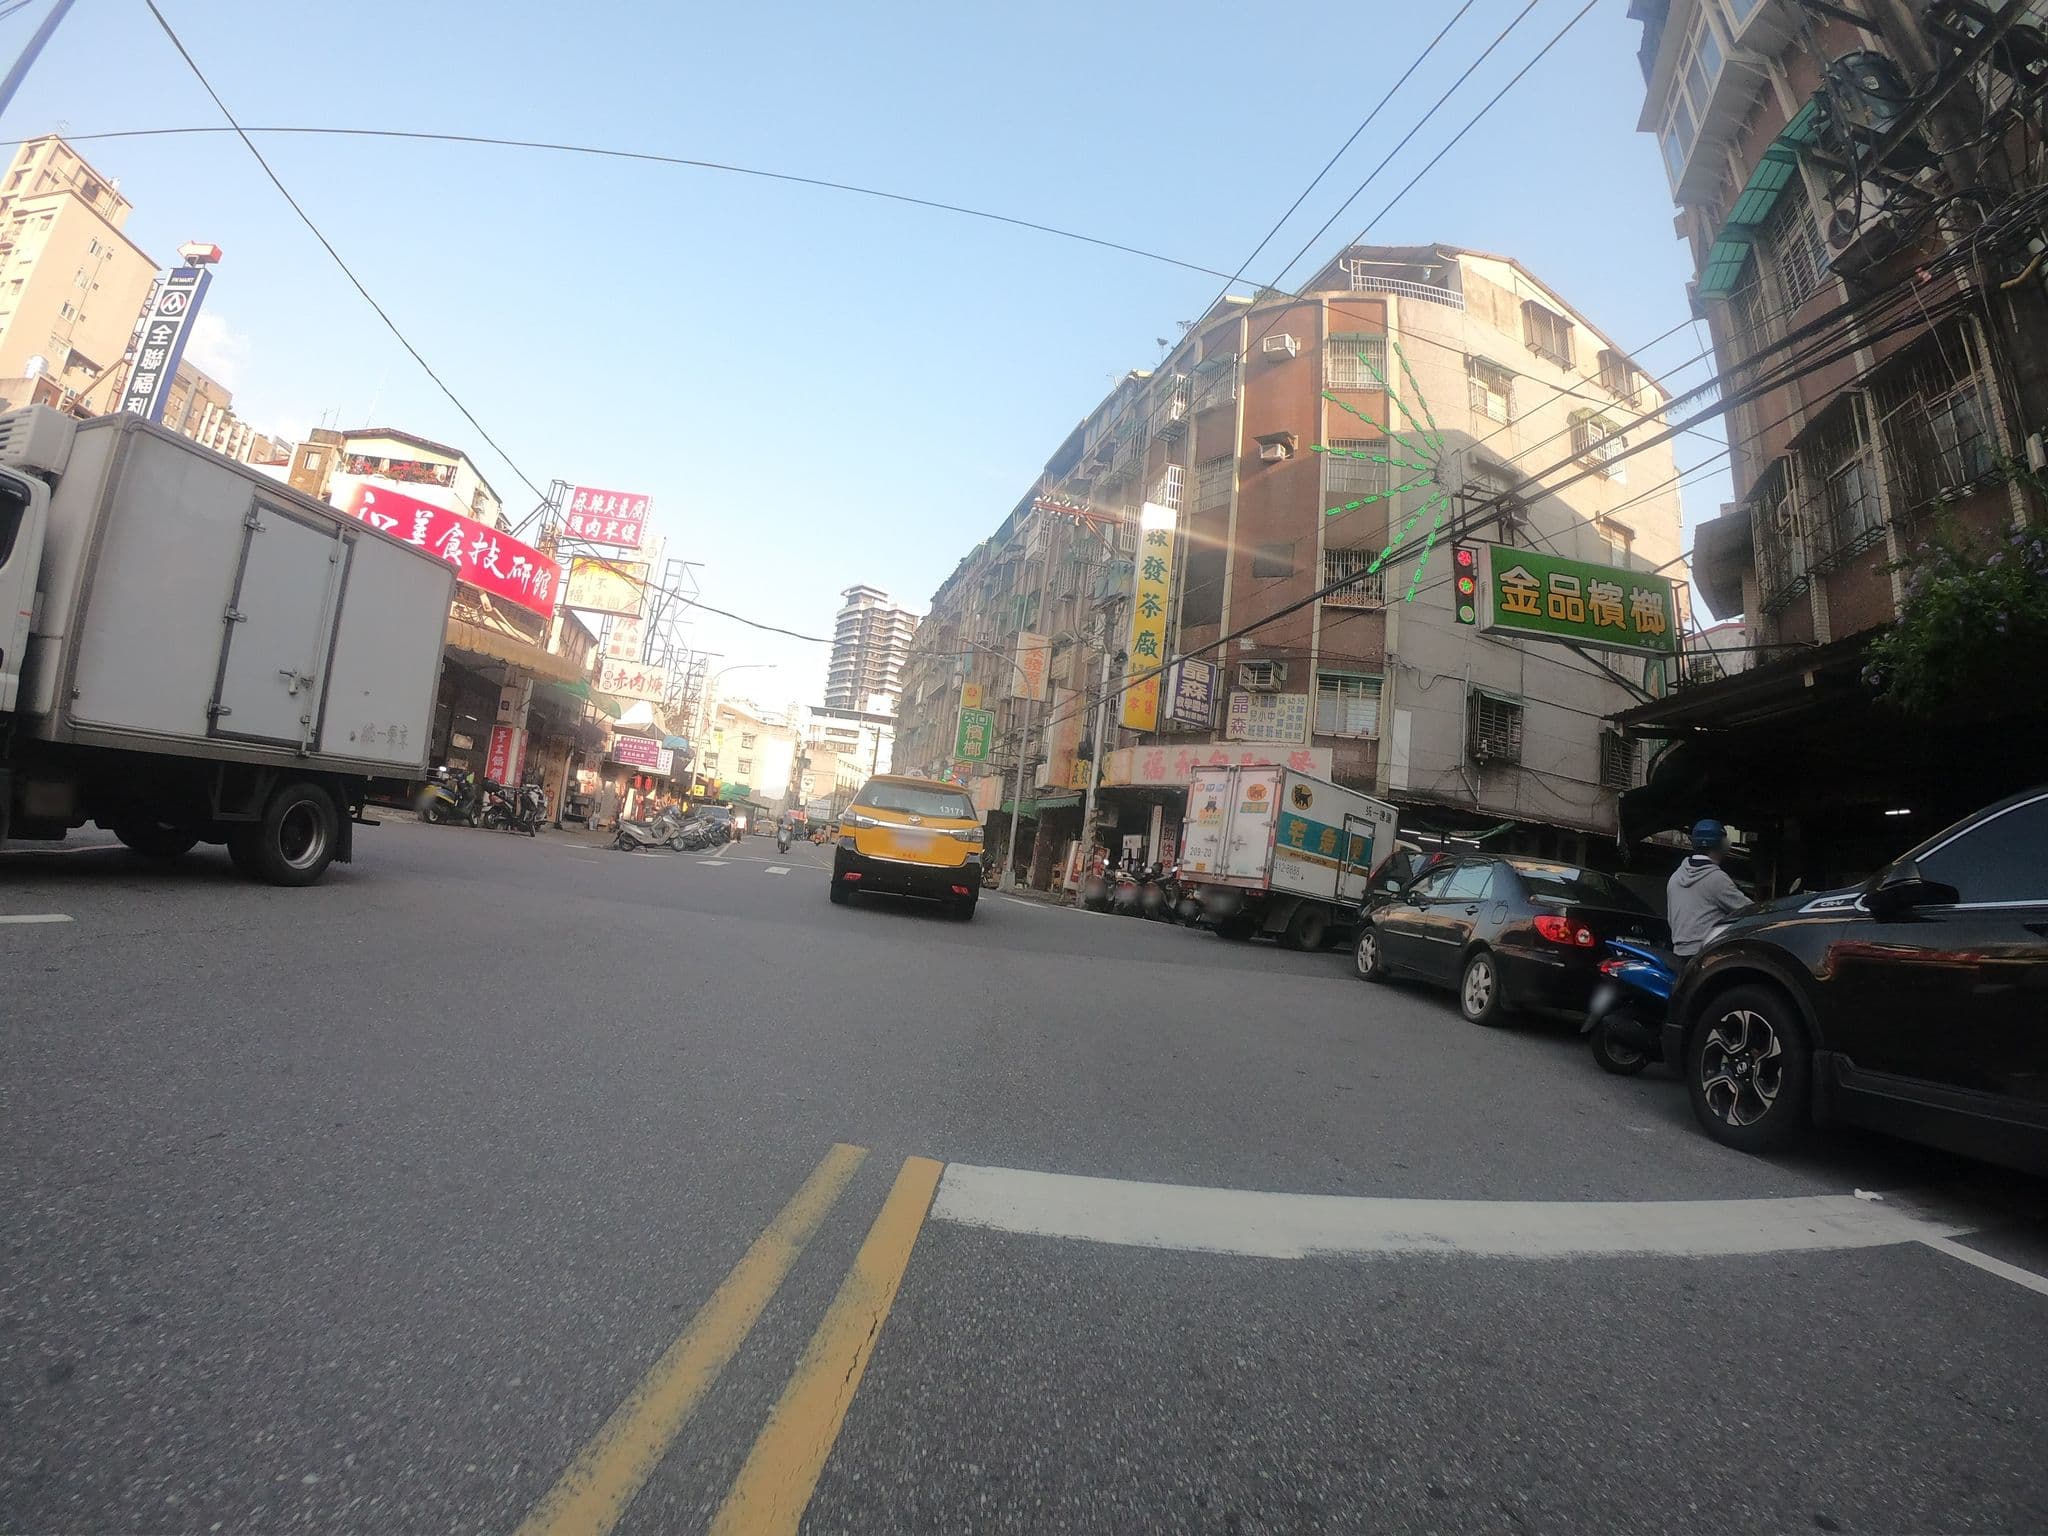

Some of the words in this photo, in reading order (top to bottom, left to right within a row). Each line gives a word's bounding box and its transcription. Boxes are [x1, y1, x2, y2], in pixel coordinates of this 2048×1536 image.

[127, 324, 173, 417] 全聯福利
[1499, 565, 1667, 636] 金品檳榔
[1181, 661, 1210, 700] 晶森
[1230, 695, 1249, 734] 晶森
